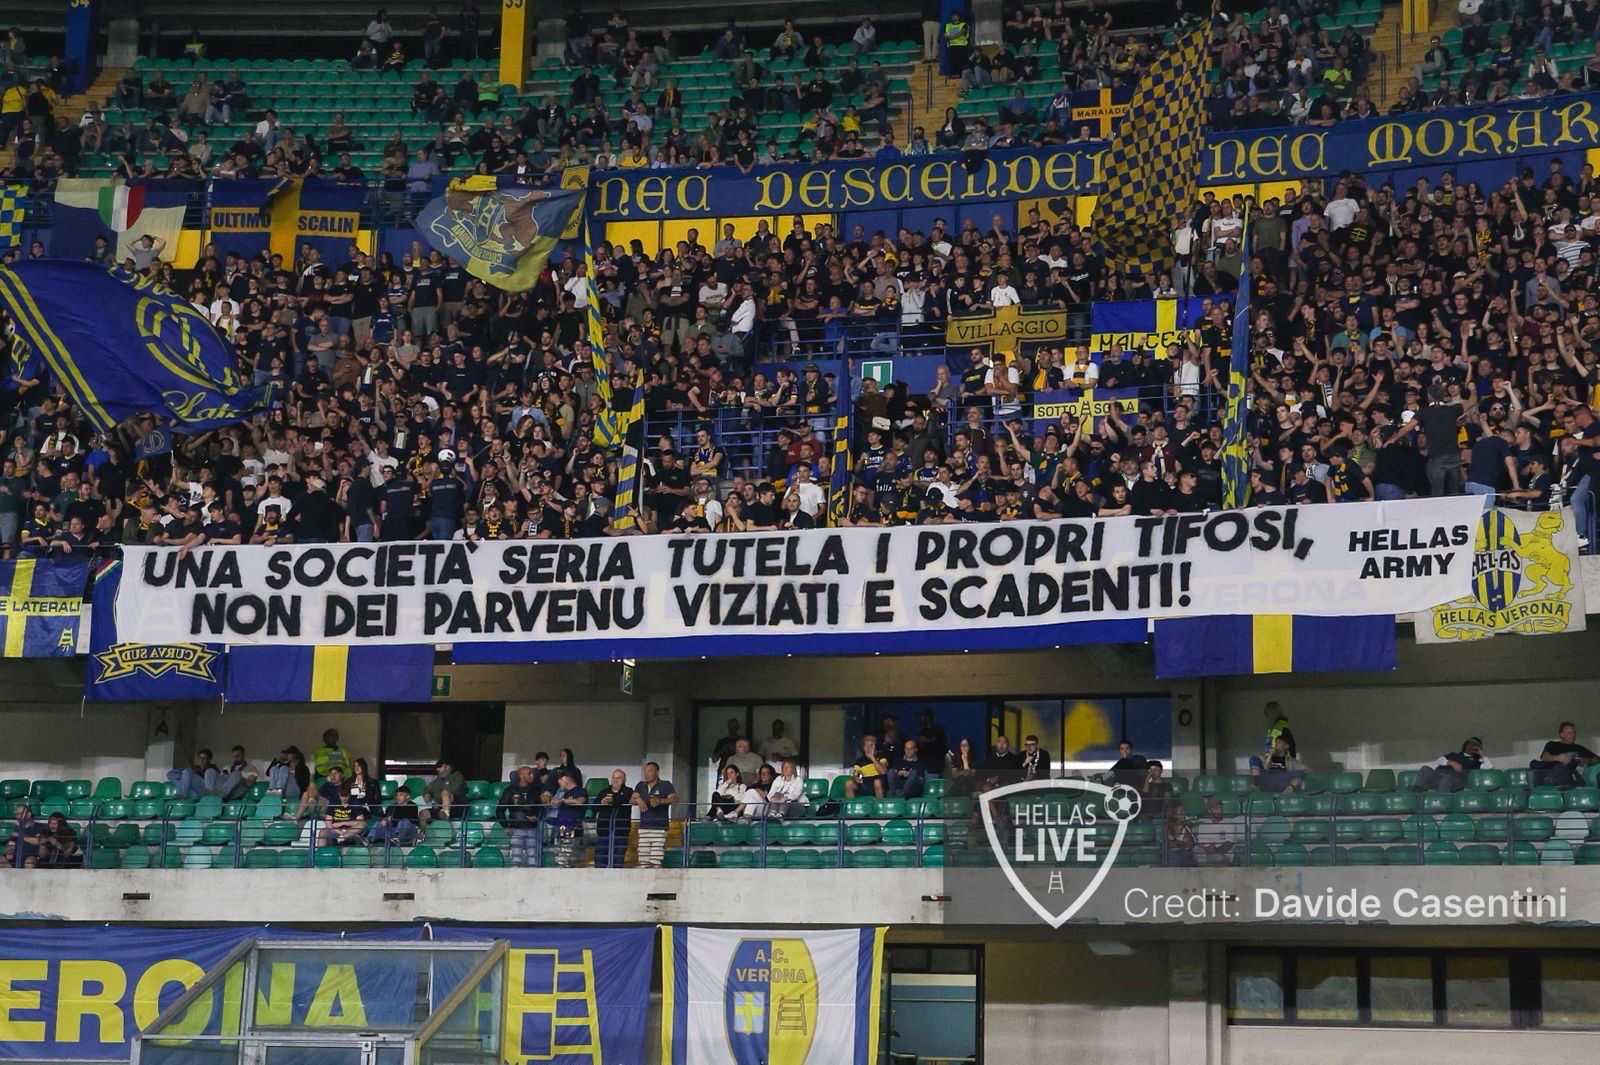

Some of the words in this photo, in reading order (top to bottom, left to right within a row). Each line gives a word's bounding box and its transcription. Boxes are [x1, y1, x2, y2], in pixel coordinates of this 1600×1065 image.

[213, 211, 272, 228] ULTIMO
[298, 214, 354, 233] SCALIN
[956, 319, 1059, 340] VILLAGGIO
[1037, 404, 1077, 417] SOTTO
[144, 551, 242, 588] UNA
[499, 543, 634, 584] SERIA
[667, 534, 849, 578] TUTELA
[876, 533, 891, 574] I
[915, 522, 1105, 573] PROPRI
[1135, 507, 1313, 560] TIFOSI,
[1349, 525, 1469, 551] HELLAS
[1360, 553, 1455, 579] ARMY
[12, 601, 80, 613] LATERALI
[191, 592, 301, 636] NON
[324, 594, 397, 637] DEI
[424, 587, 645, 635] PARVENU
[674, 583, 839, 627] VIZIATI
[865, 580, 894, 624] E
[919, 562, 1191, 620] SCADENTI!
[1440, 610, 1496, 628] HELLAS
[1500, 603, 1565, 625] VERONA
[755, 948, 789, 964] A.C.
[736, 968, 807, 983] VERONA
